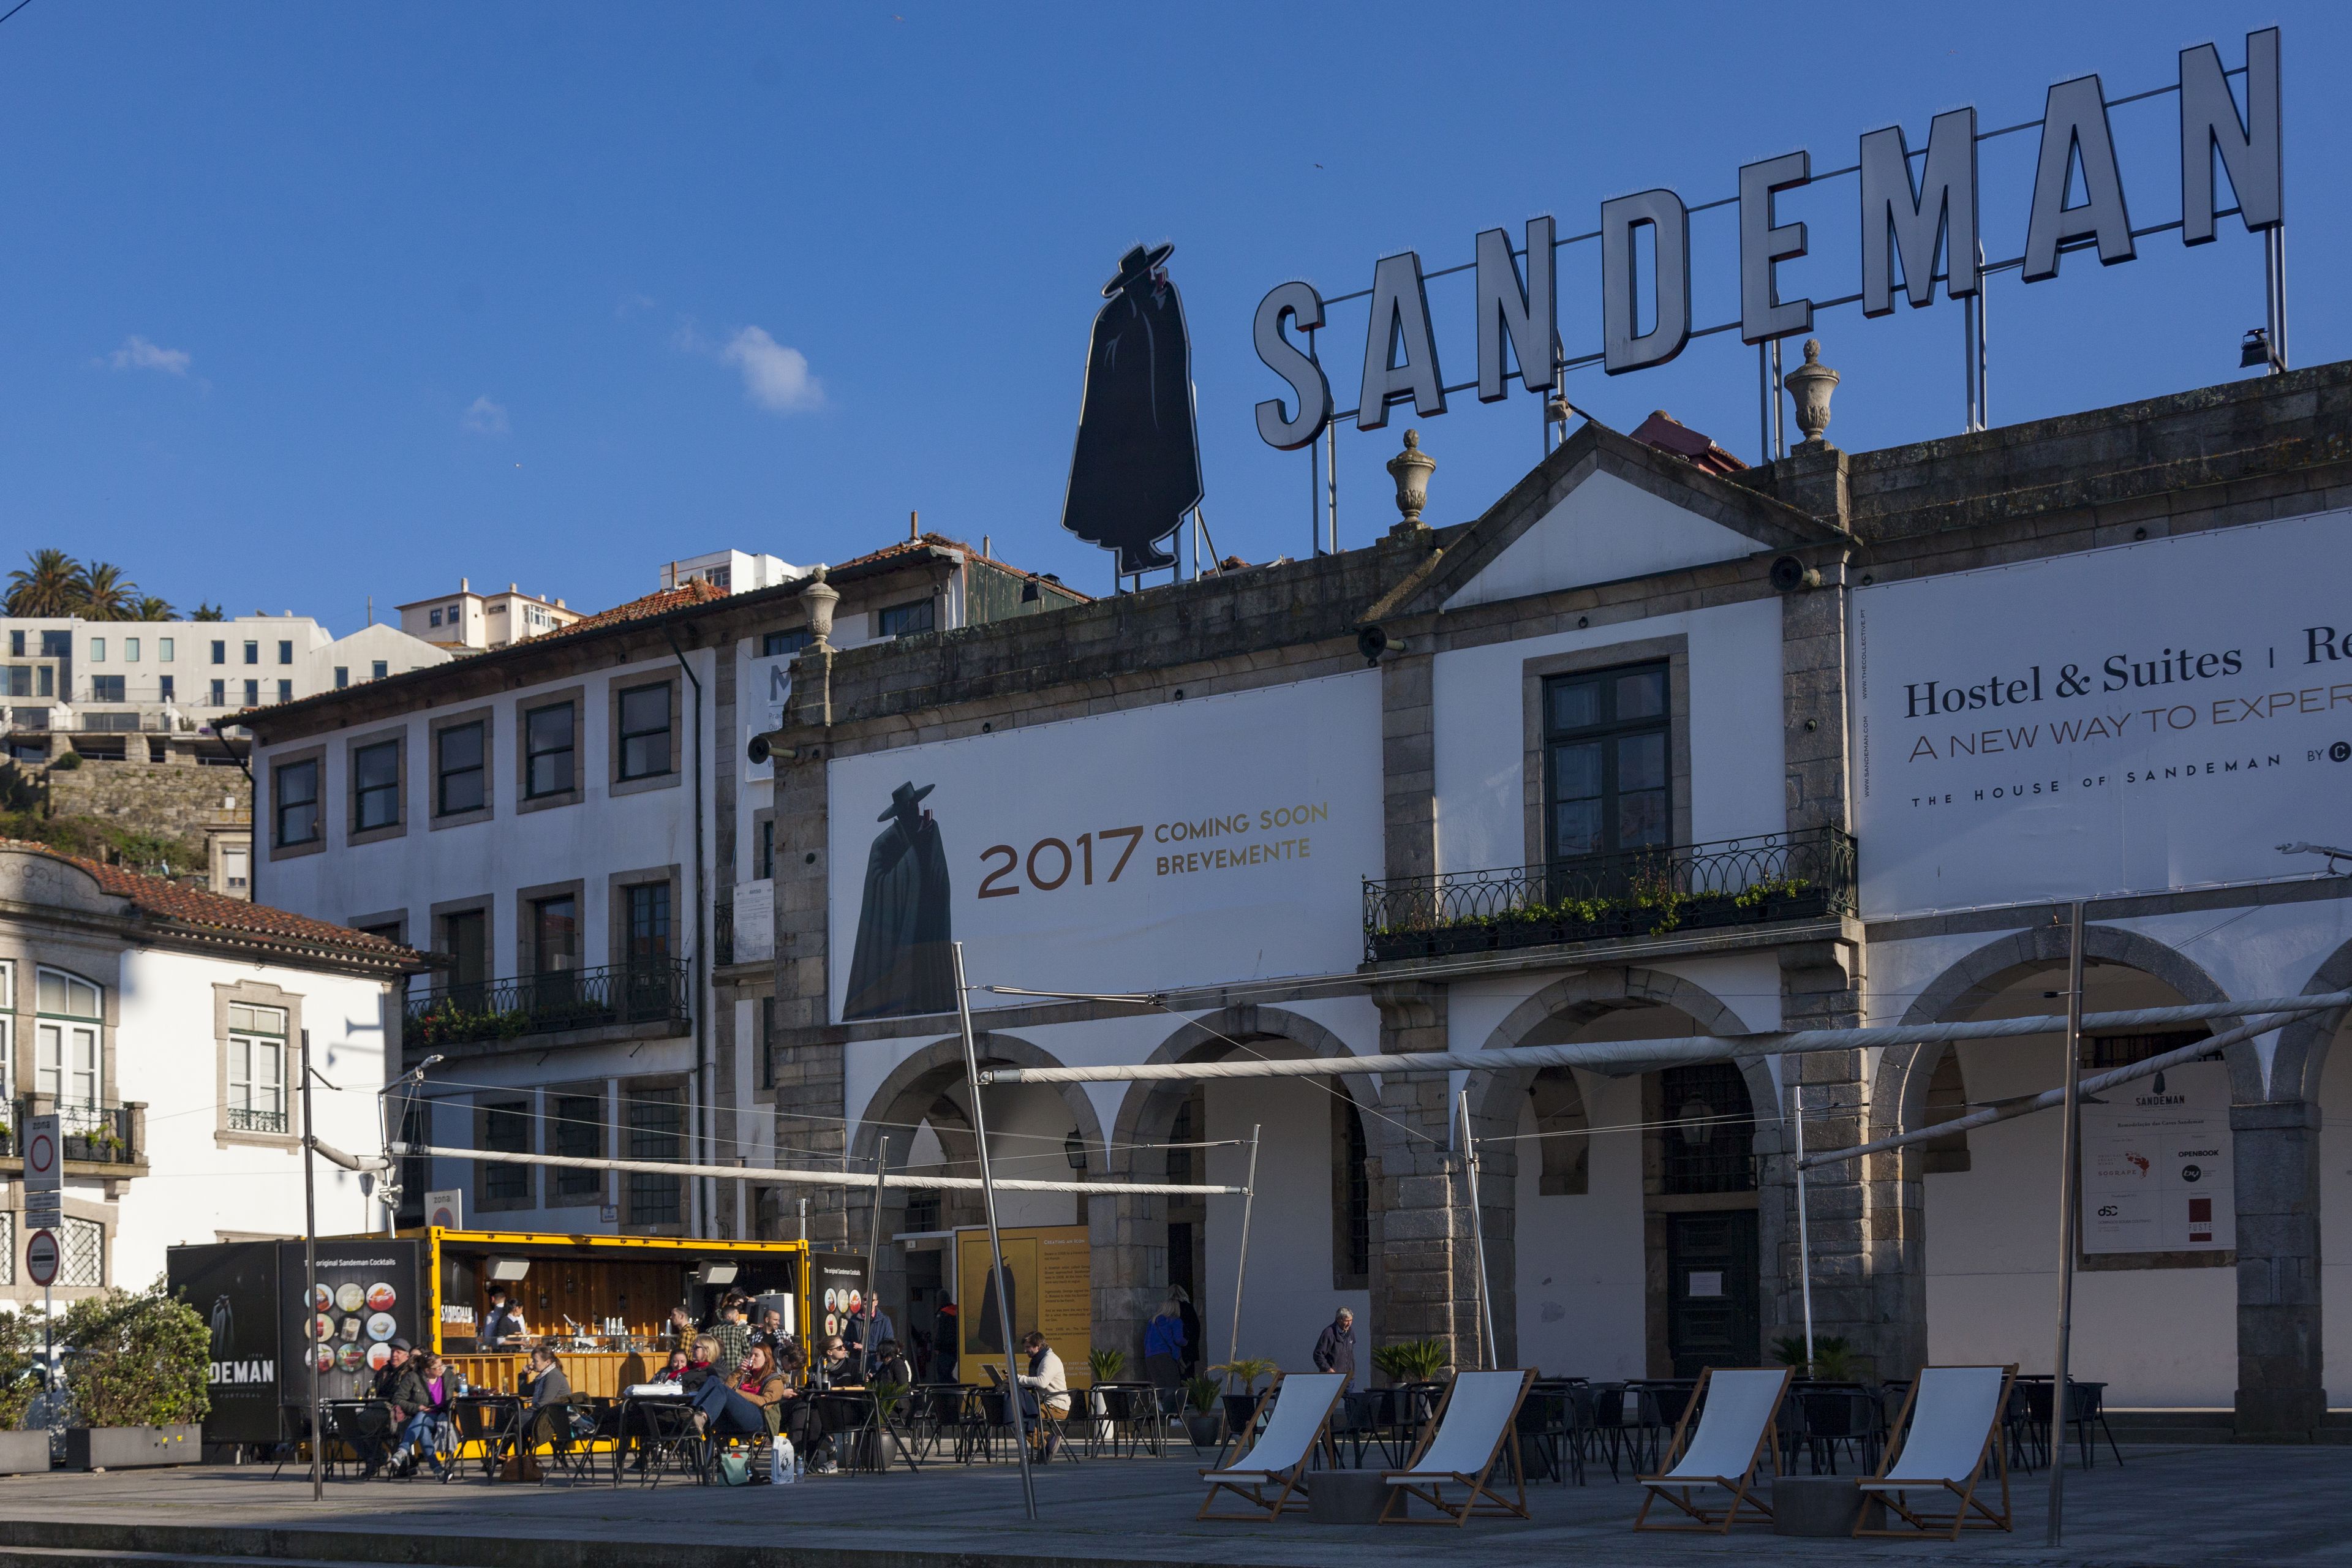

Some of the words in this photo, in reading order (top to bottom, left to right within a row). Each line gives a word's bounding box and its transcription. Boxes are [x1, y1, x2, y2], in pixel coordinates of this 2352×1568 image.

[1253, 25, 2285, 451] SANDEMAN
[1903, 665, 2044, 718] Hostel
[2056, 664, 2090, 698] &
[2103, 647, 2242, 693] Suites
[1908, 736, 1938, 763] A
[1950, 725, 2039, 758] NEW
[2049, 712, 2132, 745] WAY
[2141, 705, 2196, 733] TO
[2212, 684, 2352, 725] EXPER
[1912, 794, 1952, 807] THE
[1975, 781, 2059, 801] HOUSE
[2082, 776, 2106, 788] OF
[2127, 754, 2280, 783] SANDEMAN
[2307, 748, 2324, 762] BY
[978, 825, 1144, 899] 2017
[1154, 813, 1250, 843] COMING
[1259, 801, 1328, 830] SOON
[1156, 837, 1311, 876] BREVEMENTE
[2136, 1095, 2185, 1106] SANDEMAN
[32, 1121, 51, 1130] zona
[2188, 1223, 2212, 1231] FUSTE
[209, 1360, 274, 1384] DEMAN
